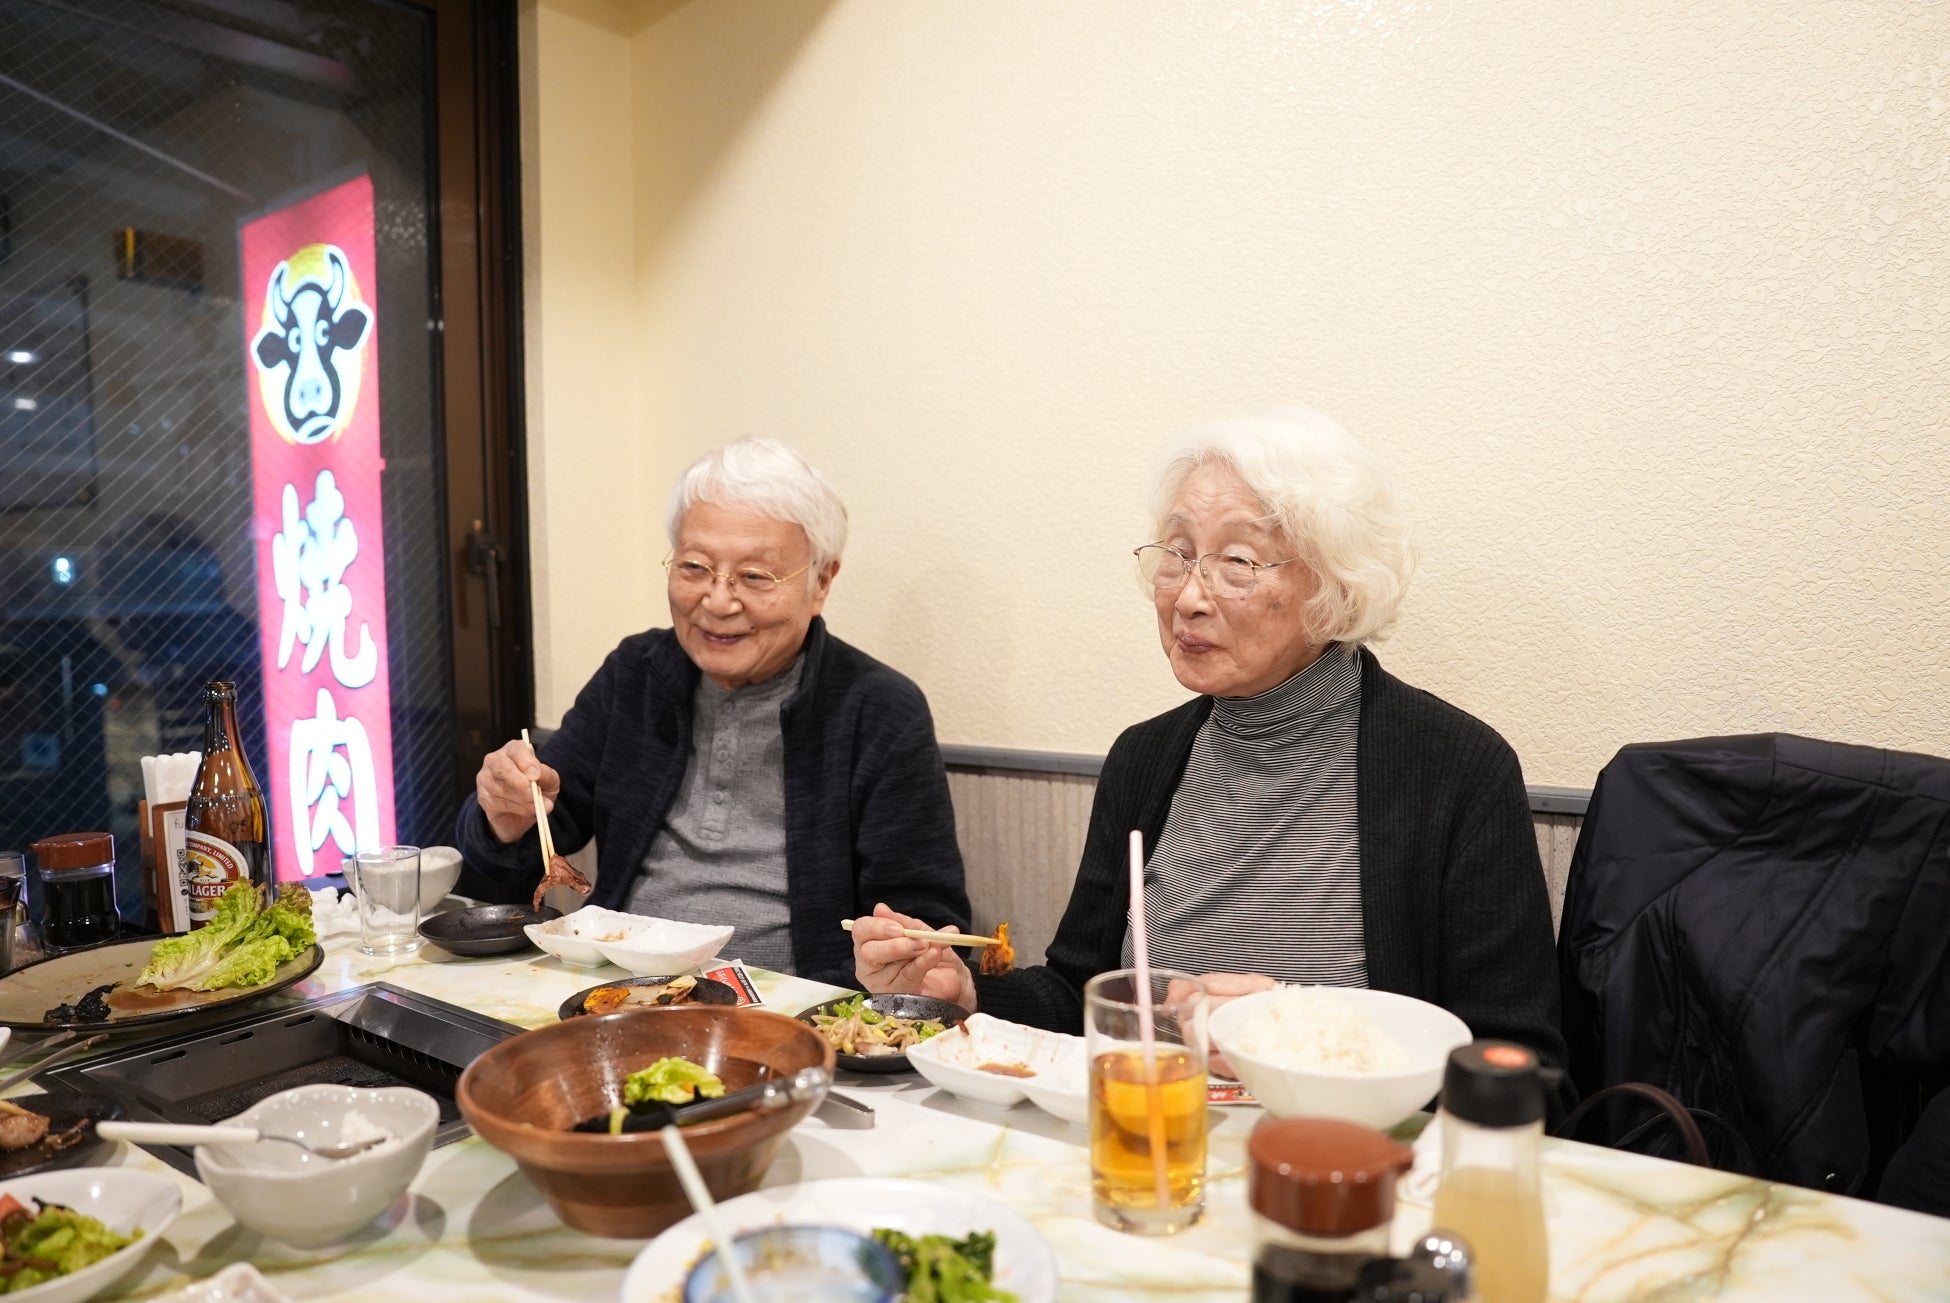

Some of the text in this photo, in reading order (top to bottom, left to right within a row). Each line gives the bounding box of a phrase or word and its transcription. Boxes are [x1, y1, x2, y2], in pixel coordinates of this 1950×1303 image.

[272, 468, 379, 876] 焼肉
[213, 850, 234, 869] LIMITED
[191, 885, 225, 896] LAGER
